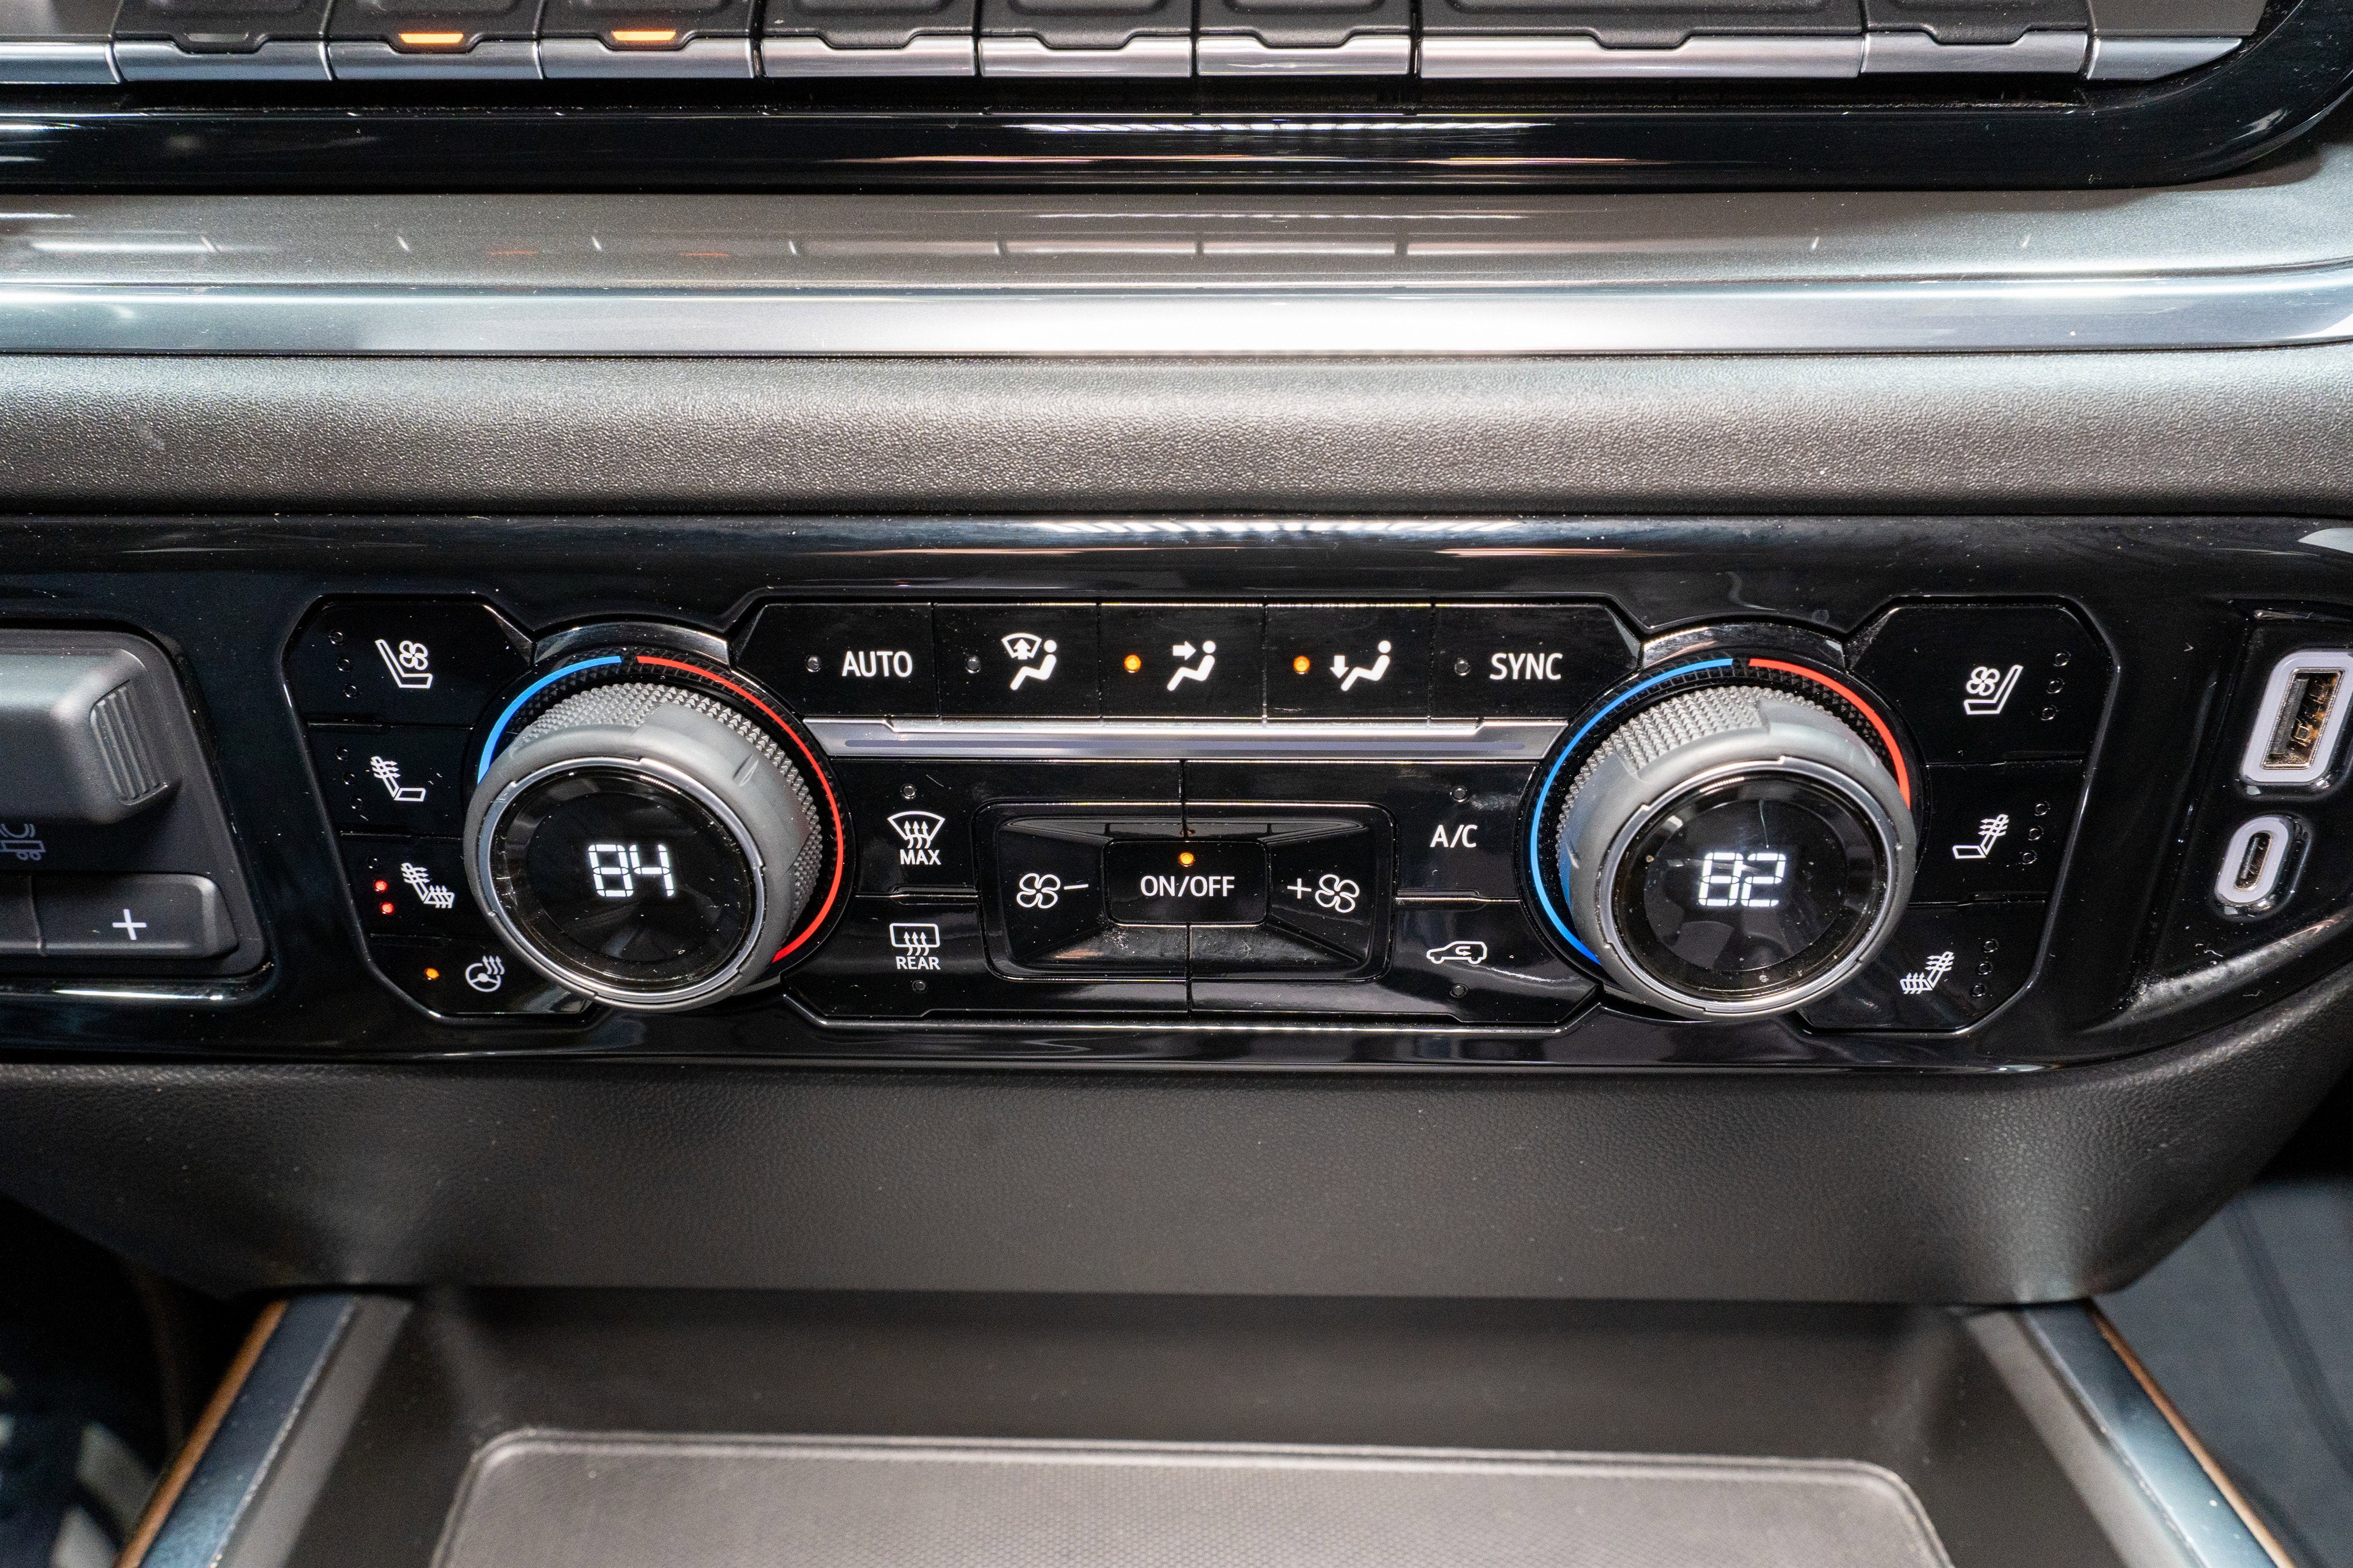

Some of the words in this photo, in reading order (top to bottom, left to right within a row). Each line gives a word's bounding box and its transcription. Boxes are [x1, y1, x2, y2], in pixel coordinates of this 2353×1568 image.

[842, 651, 913, 678] AUTO
[1489, 652, 1563, 681] SYNC
[1429, 824, 1478, 848] A/C
[900, 849, 942, 865] MAX
[588, 843, 675, 897] 84
[1698, 851, 1787, 907] 82
[1140, 875, 1235, 897] ON/OFF
[895, 956, 941, 970] REAR
